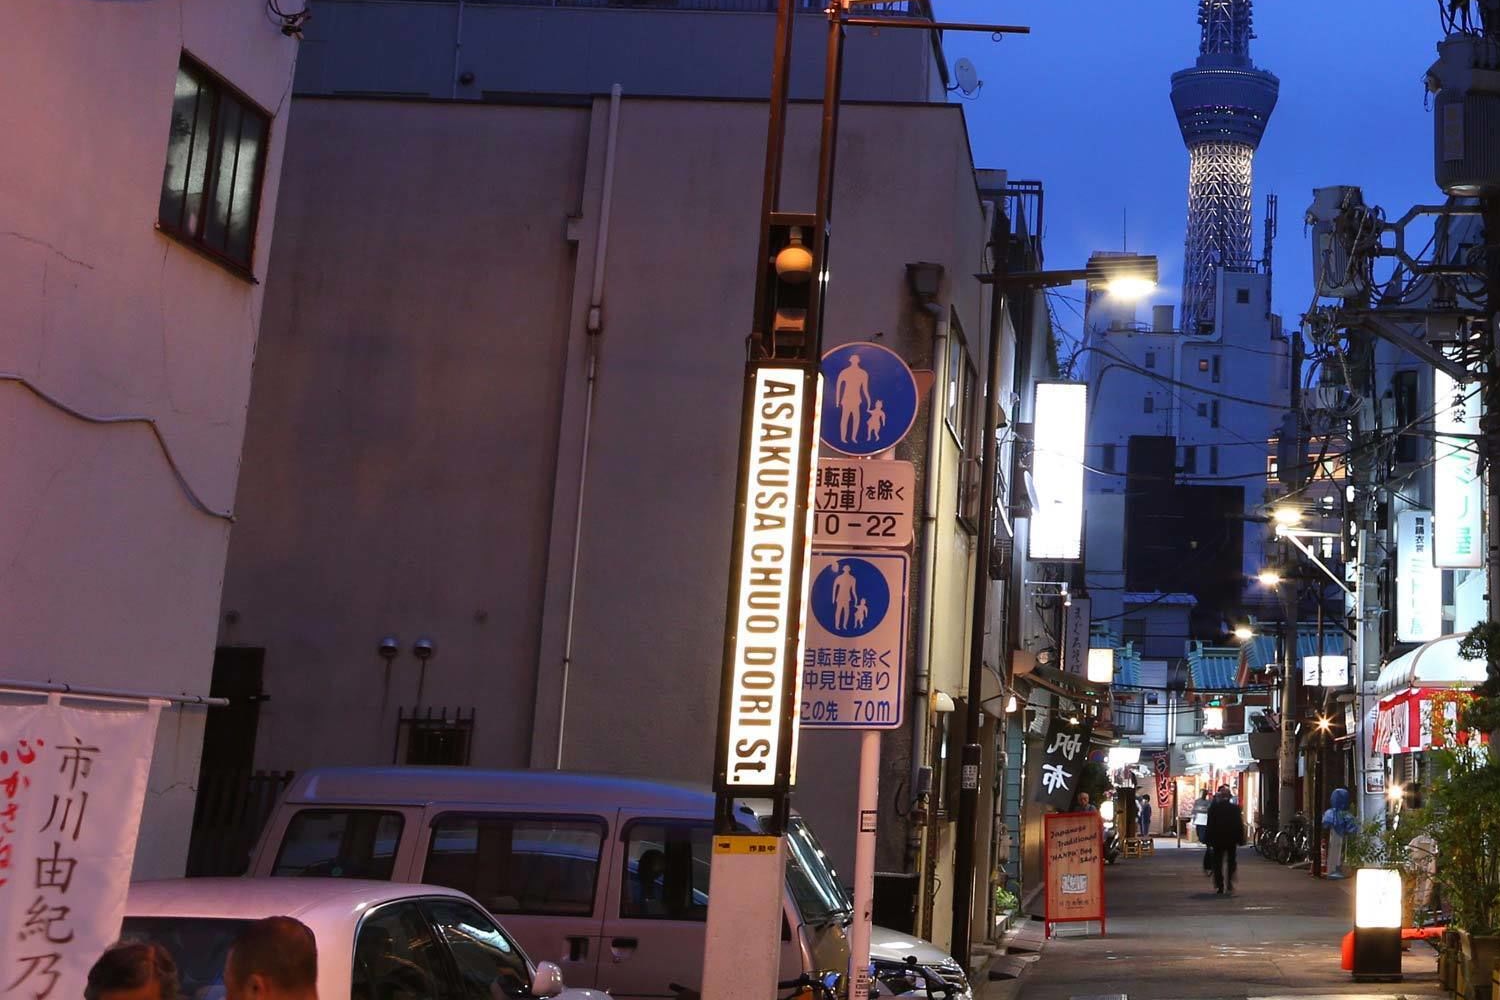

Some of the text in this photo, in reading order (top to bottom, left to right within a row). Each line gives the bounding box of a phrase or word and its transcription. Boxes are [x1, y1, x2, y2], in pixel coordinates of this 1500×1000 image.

[865, 479, 905, 501] を除く
[733, 379, 796, 782] ASAKUSA CHUO DORI St.
[803, 647, 891, 668] 自転車を除く
[801, 669, 890, 691] 仲見世通り
[800, 700, 890, 721] この先 70m
[1057, 832, 1097, 847] Traditional
[4, 735, 101, 1000] 市川由紀乃
